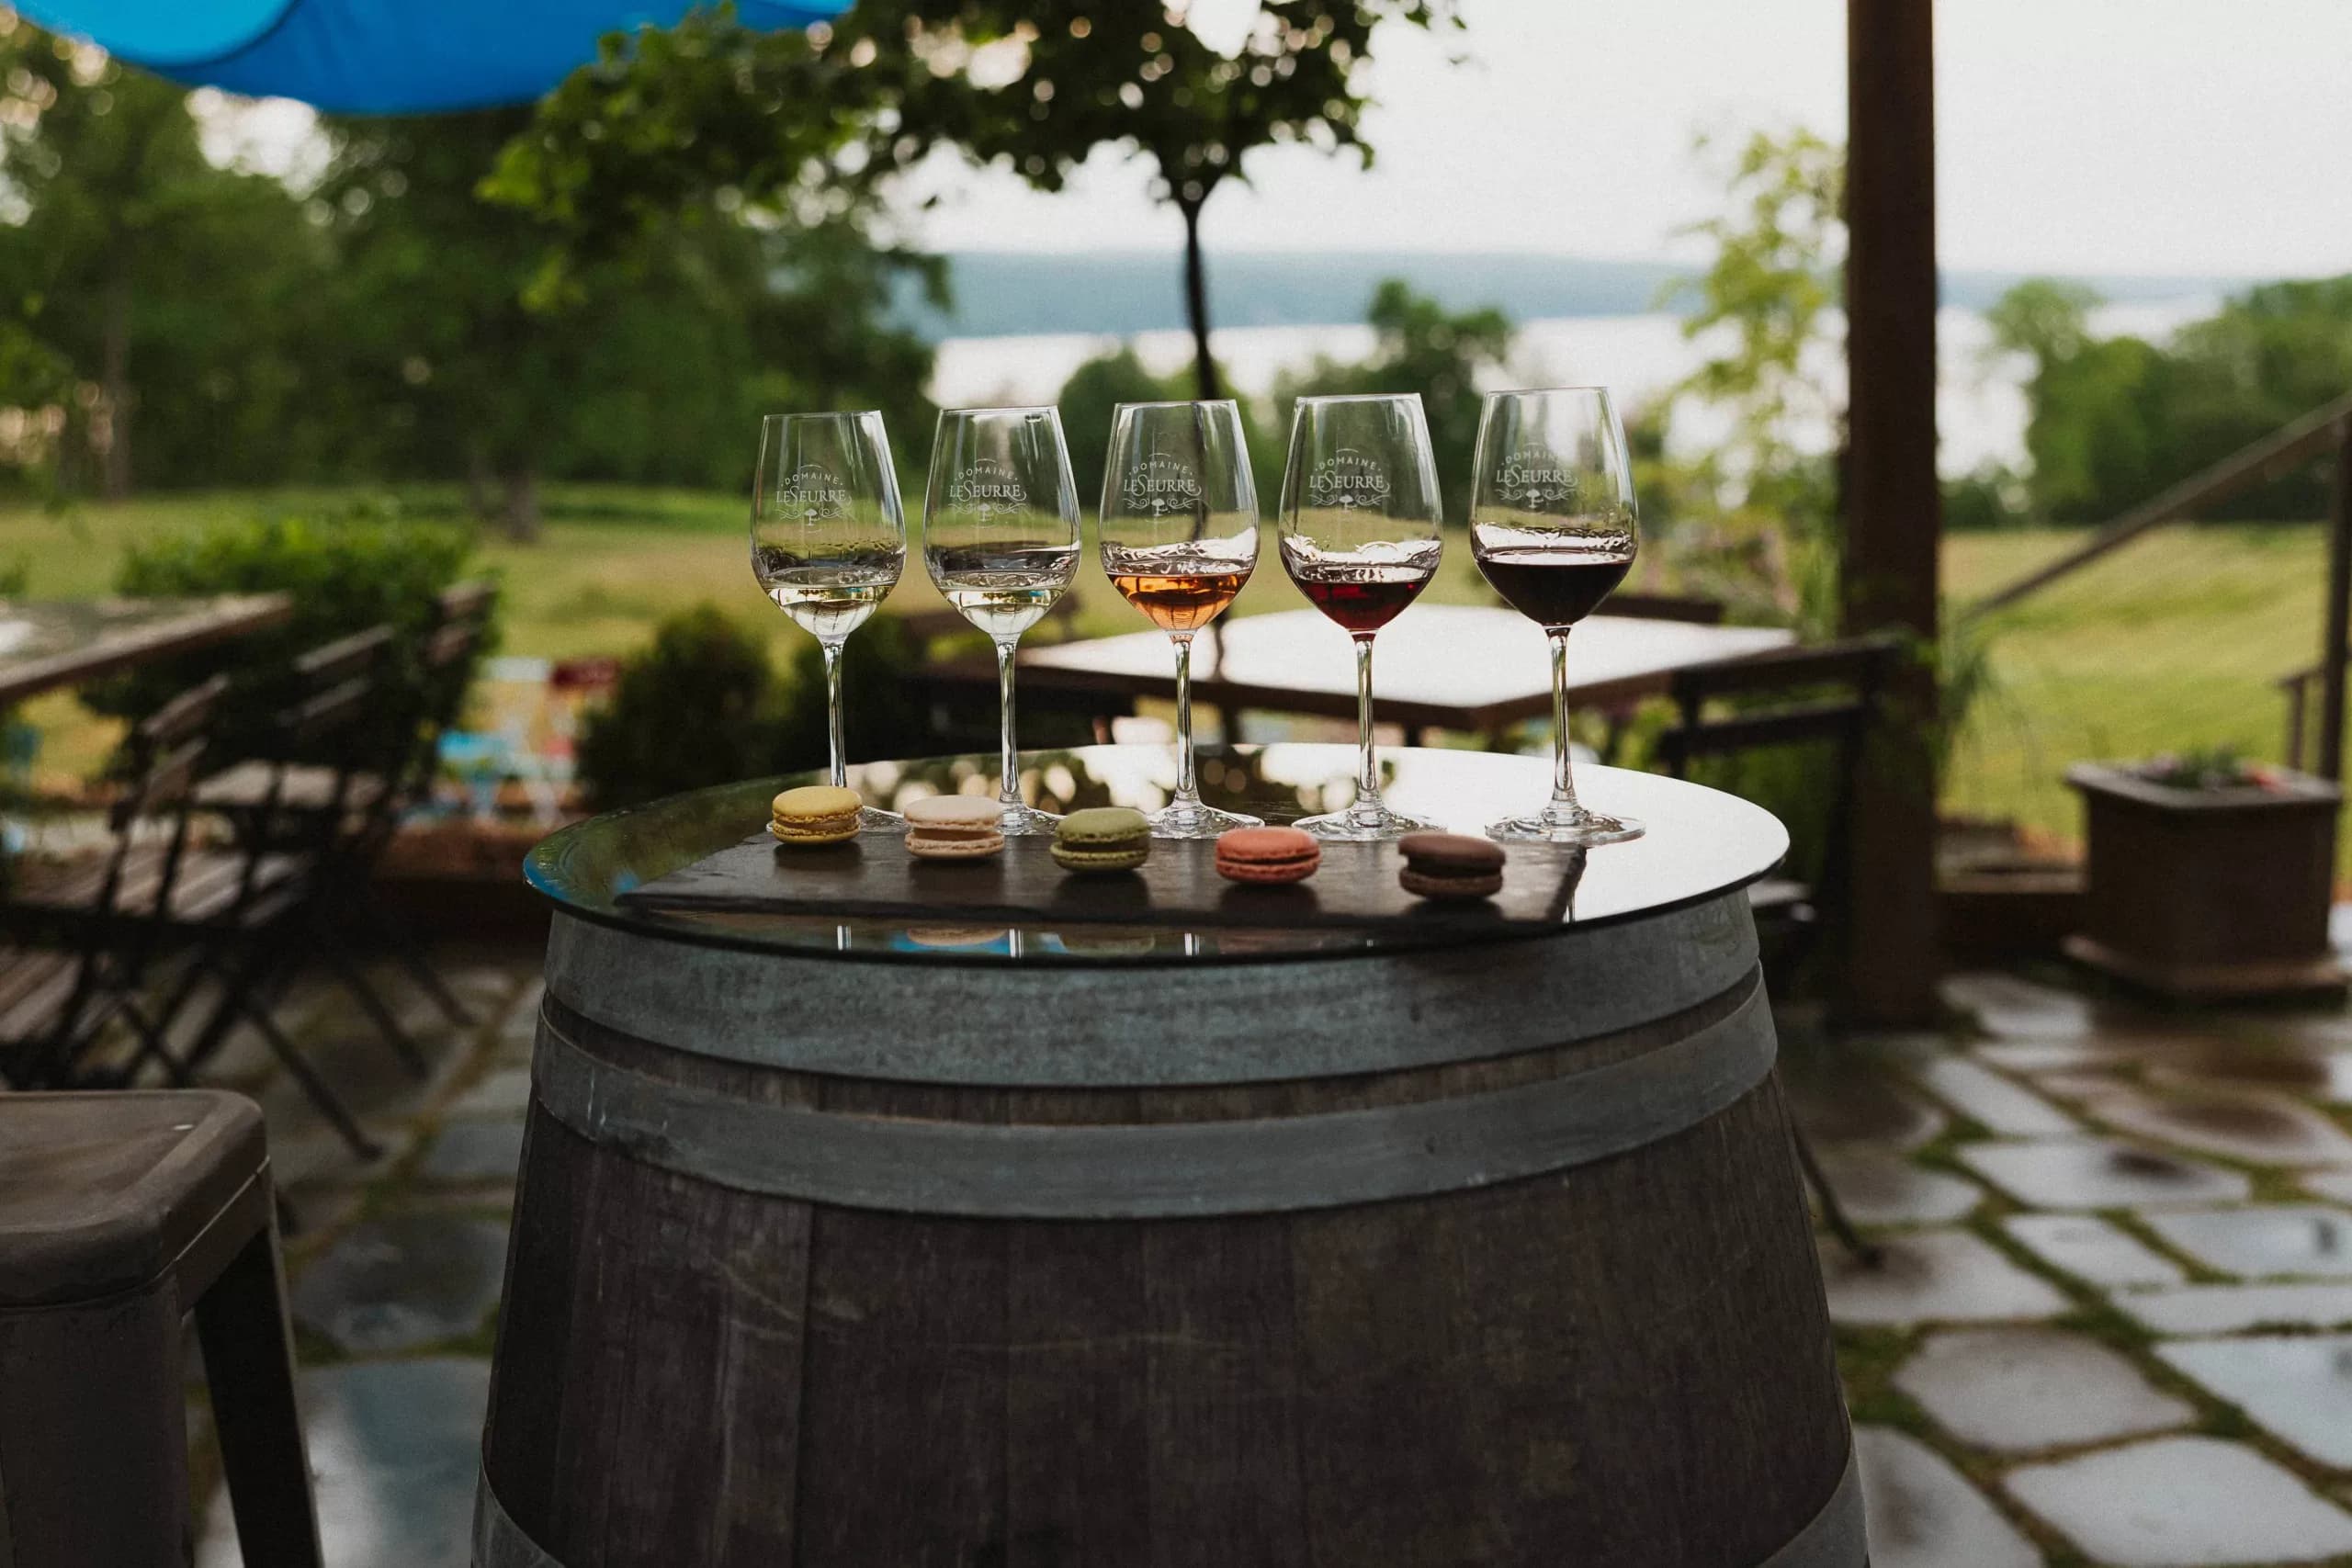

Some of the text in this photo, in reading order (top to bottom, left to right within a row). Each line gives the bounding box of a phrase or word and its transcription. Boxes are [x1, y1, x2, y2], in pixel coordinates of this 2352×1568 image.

[1133, 461, 1189, 475] DOMAINE
[1319, 457, 1376, 470] DOMAINE
[785, 472, 840, 486] DOMAINE
[958, 467, 1015, 479] DOMAINE
